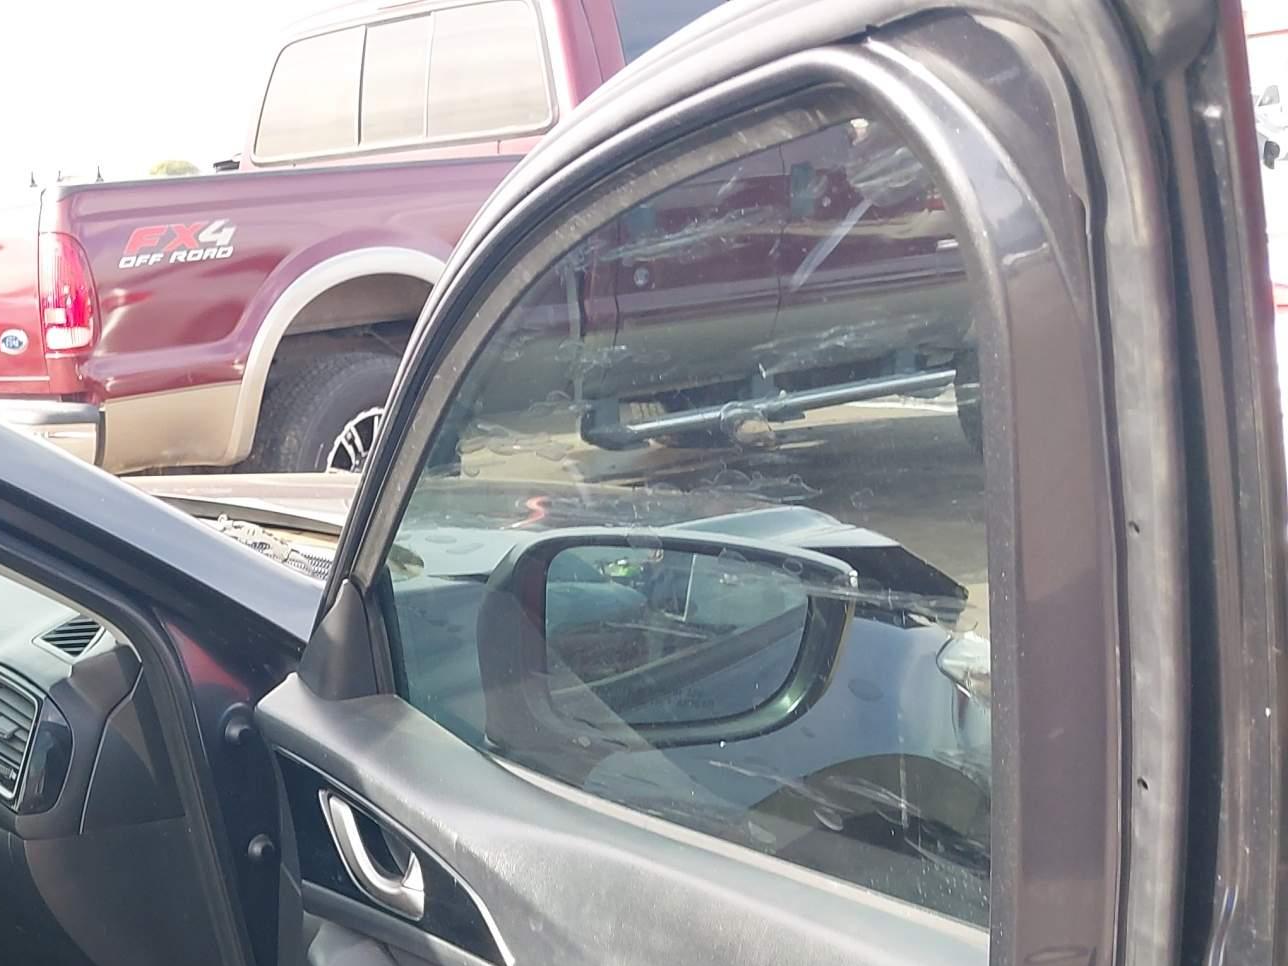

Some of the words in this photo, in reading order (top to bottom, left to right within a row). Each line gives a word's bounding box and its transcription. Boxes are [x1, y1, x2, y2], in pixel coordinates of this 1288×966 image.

[123, 219, 236, 256] FX4
[118, 253, 164, 269] OFF
[169, 246, 234, 263] ROAD
